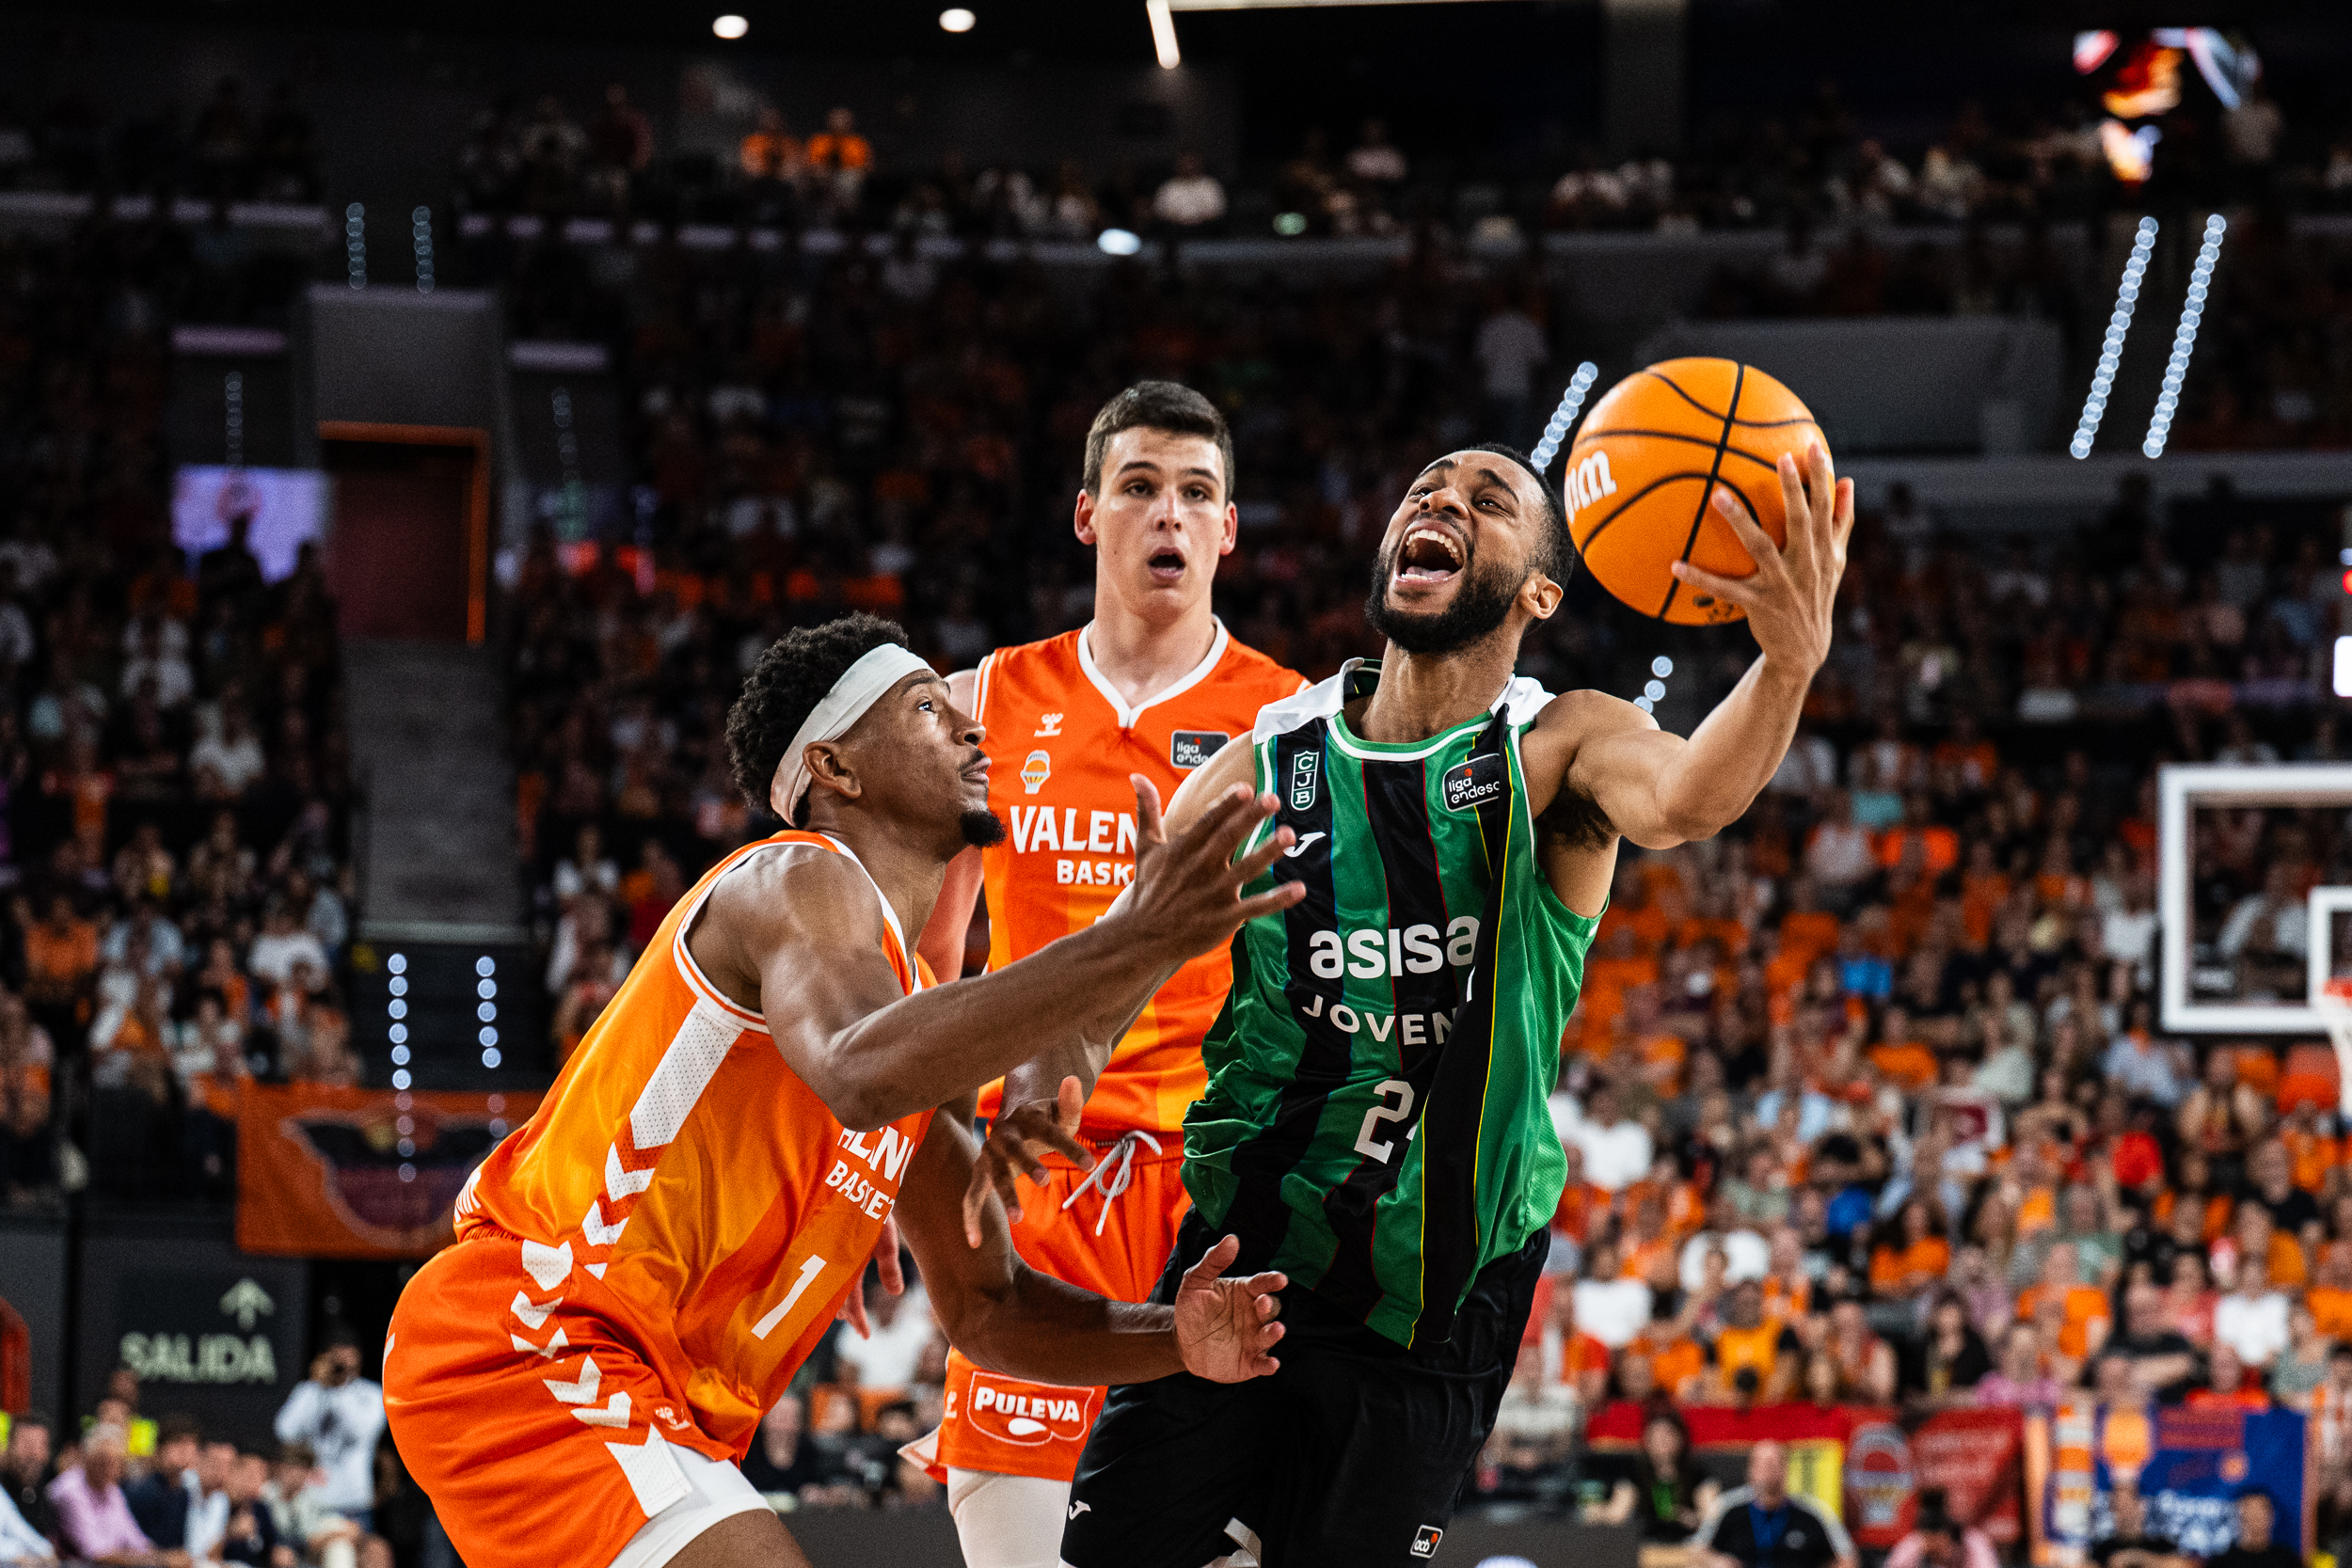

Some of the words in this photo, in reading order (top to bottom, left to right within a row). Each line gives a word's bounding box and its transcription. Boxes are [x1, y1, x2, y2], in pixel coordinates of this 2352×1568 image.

[1176, 740, 1200, 754] liga
[1449, 777, 1472, 793] liga
[1009, 805, 1137, 854] VALEN
[1057, 859, 1134, 886] BASK
[1309, 915, 1481, 979] asisa
[1353, 1079, 1418, 1164] 2
[750, 1253, 828, 1341] 1
[119, 1330, 278, 1385] SALIDA
[974, 1386, 1081, 1423] PULEVA
